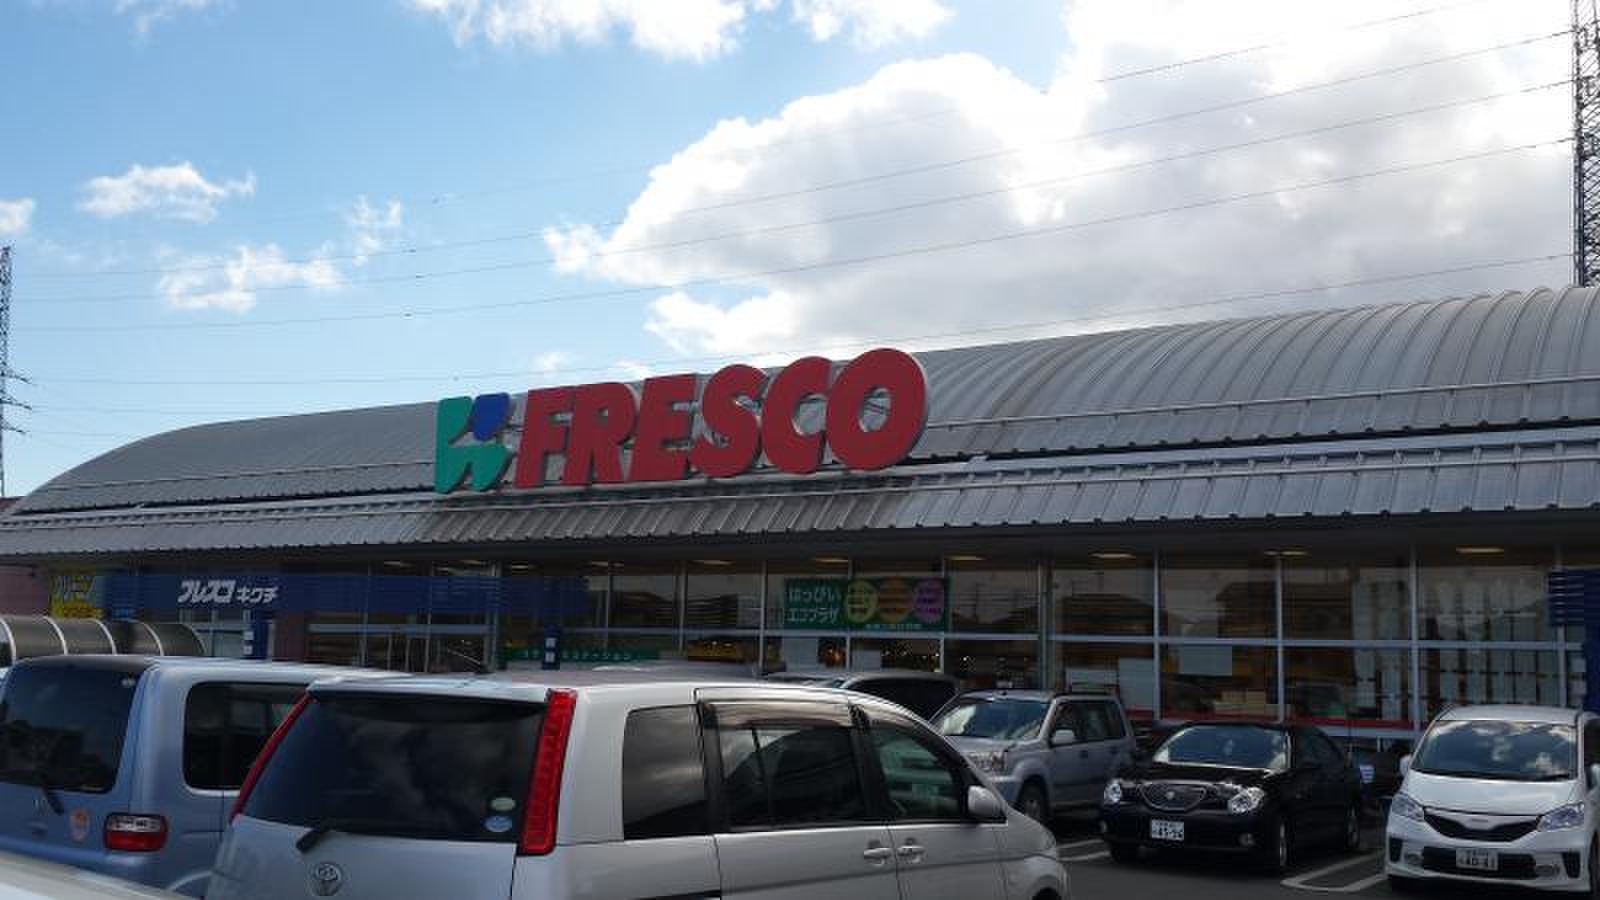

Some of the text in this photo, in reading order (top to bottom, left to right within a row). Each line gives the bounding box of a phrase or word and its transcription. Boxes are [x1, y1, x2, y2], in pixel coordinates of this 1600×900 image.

[516, 347, 926, 488] FRESCO
[177, 579, 279, 603] フレスコ キクチ
